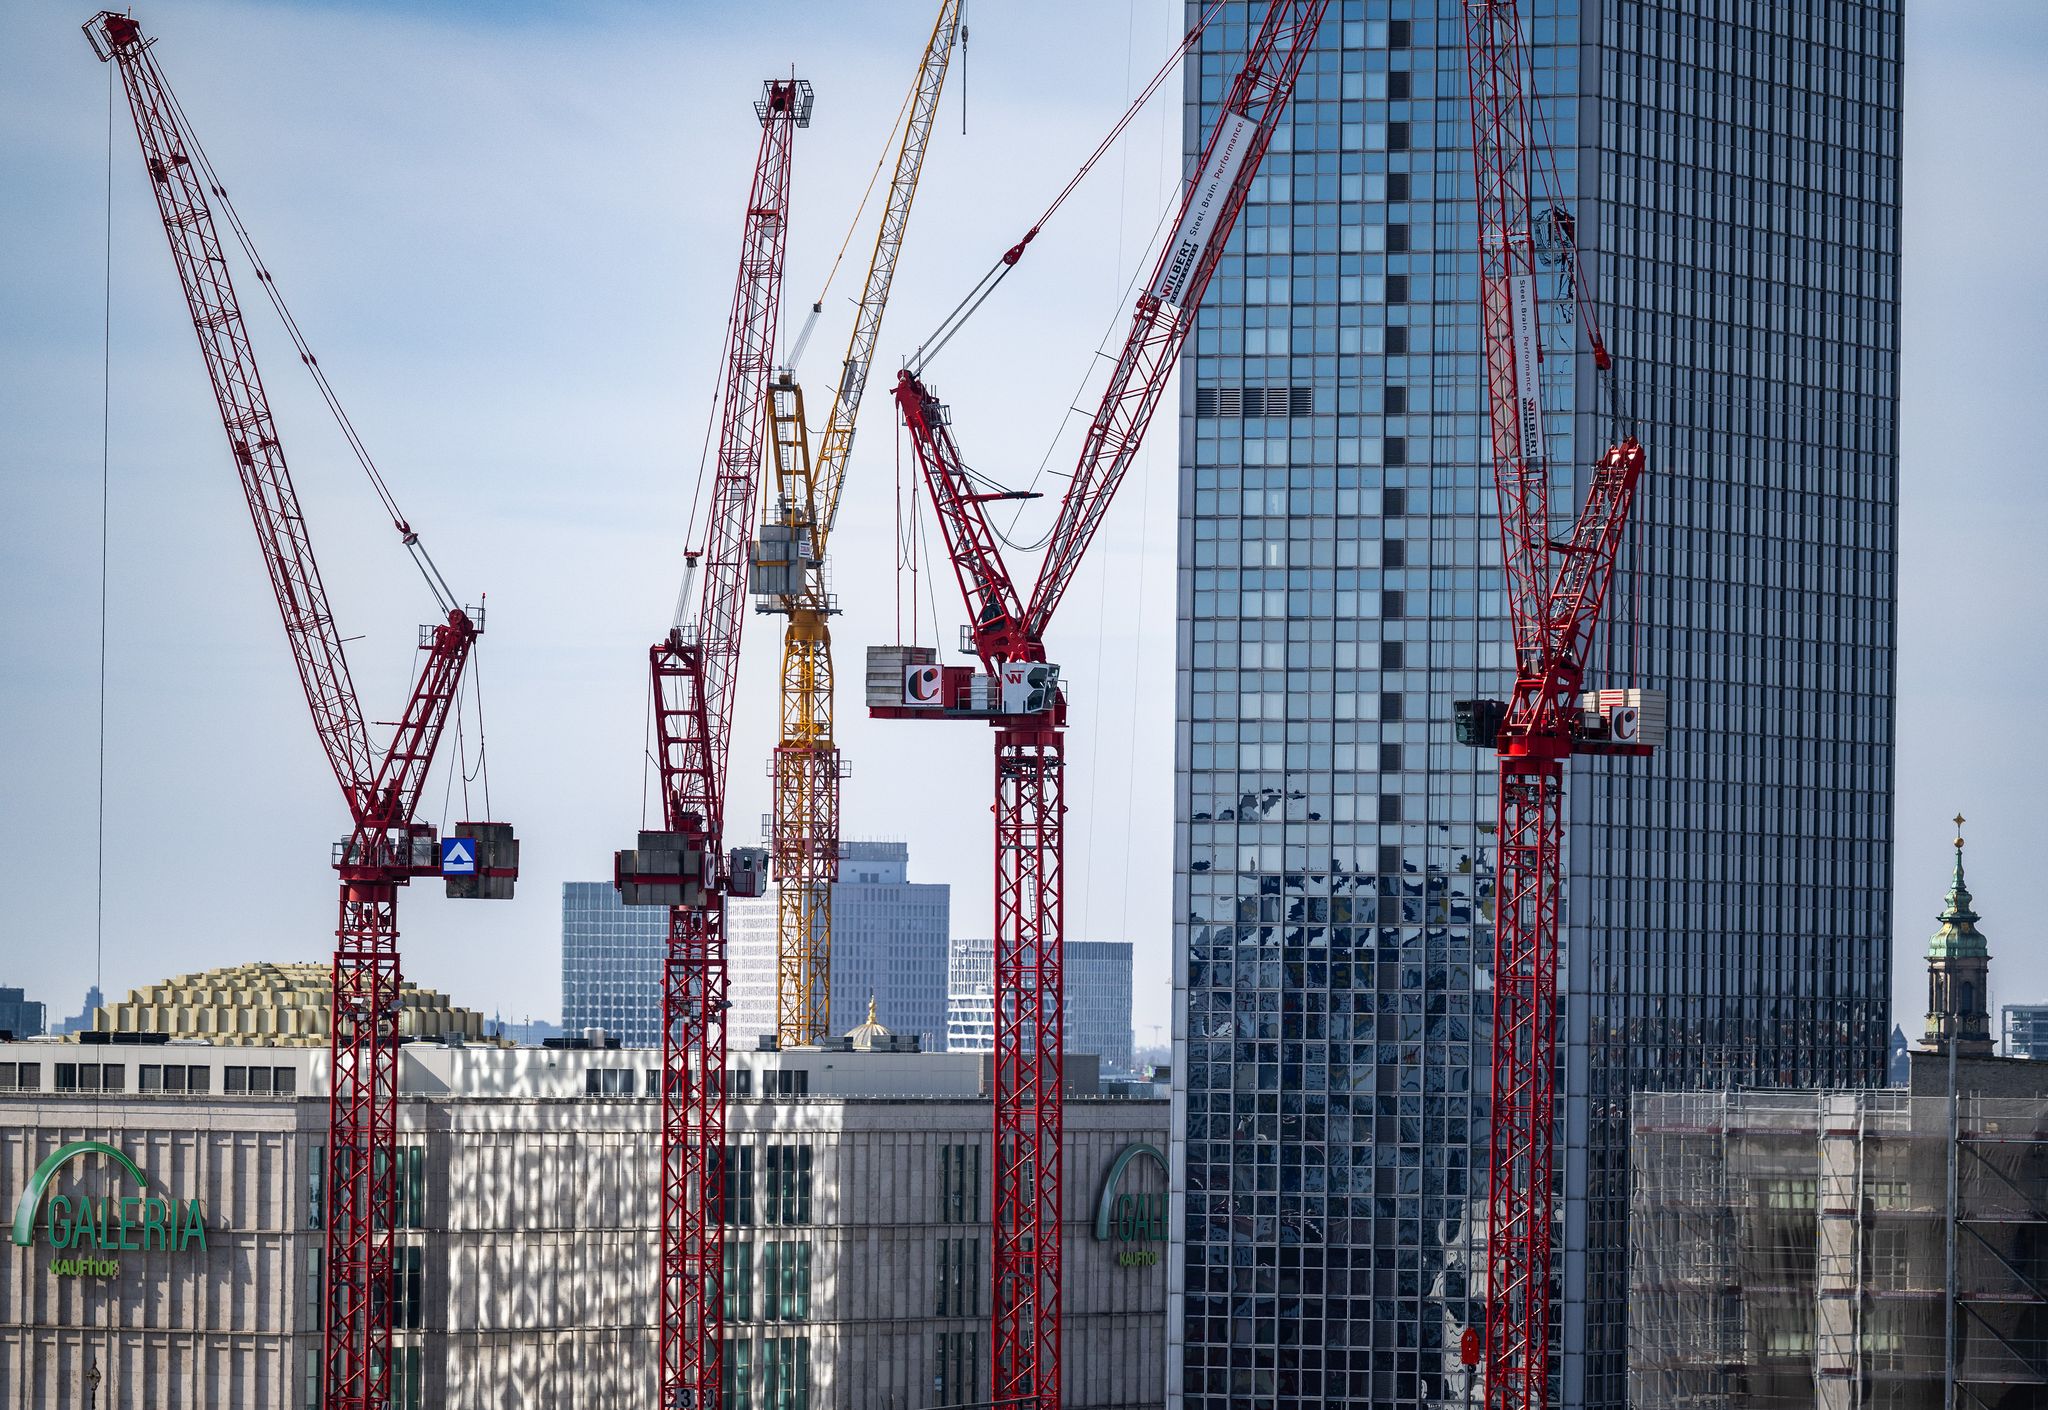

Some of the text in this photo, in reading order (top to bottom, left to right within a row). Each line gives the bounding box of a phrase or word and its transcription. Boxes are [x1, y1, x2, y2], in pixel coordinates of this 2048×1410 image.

[1161, 120, 1246, 298] WILBERT Steel. Brain. Performance.
[1170, 244, 1199, 303] TOWER CRANES
[1523, 336, 1533, 395] Performance.
[1528, 397, 1538, 456] WILBERT
[47, 1195, 208, 1252] GALERIA
[680, 1389, 691, 1408] 3
[707, 1389, 714, 1407] 3
